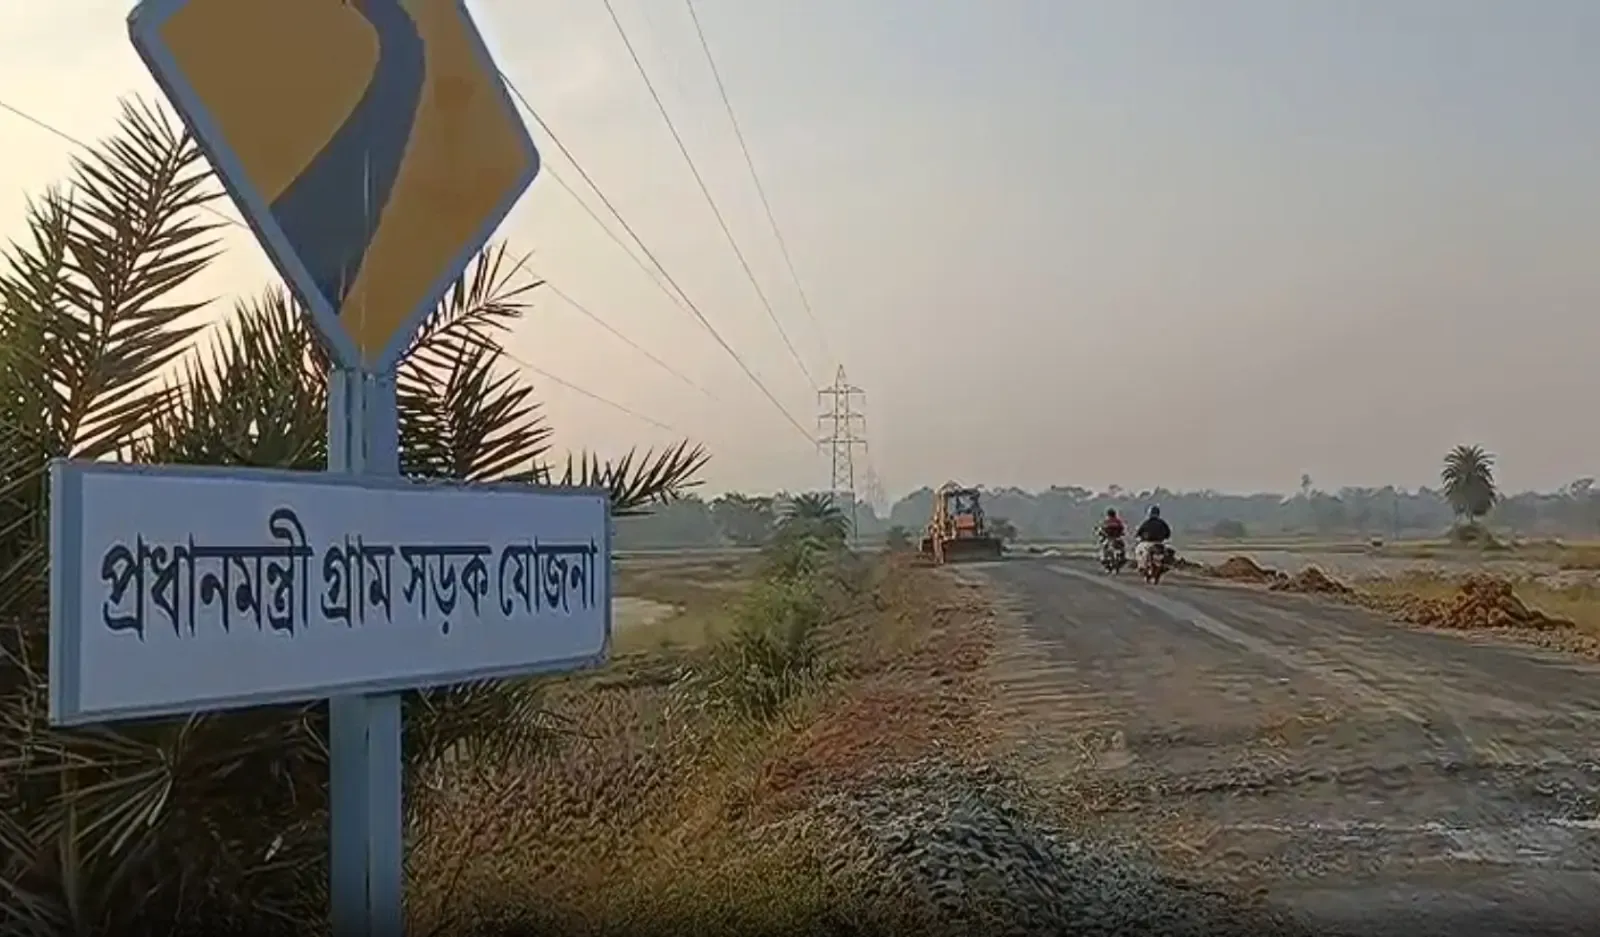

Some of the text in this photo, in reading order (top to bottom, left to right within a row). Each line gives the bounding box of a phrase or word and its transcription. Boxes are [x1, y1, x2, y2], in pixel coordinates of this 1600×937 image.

[101, 508, 598, 641] প্রধানমন্ত্রী গ্রাম সড়ক যোজনা
